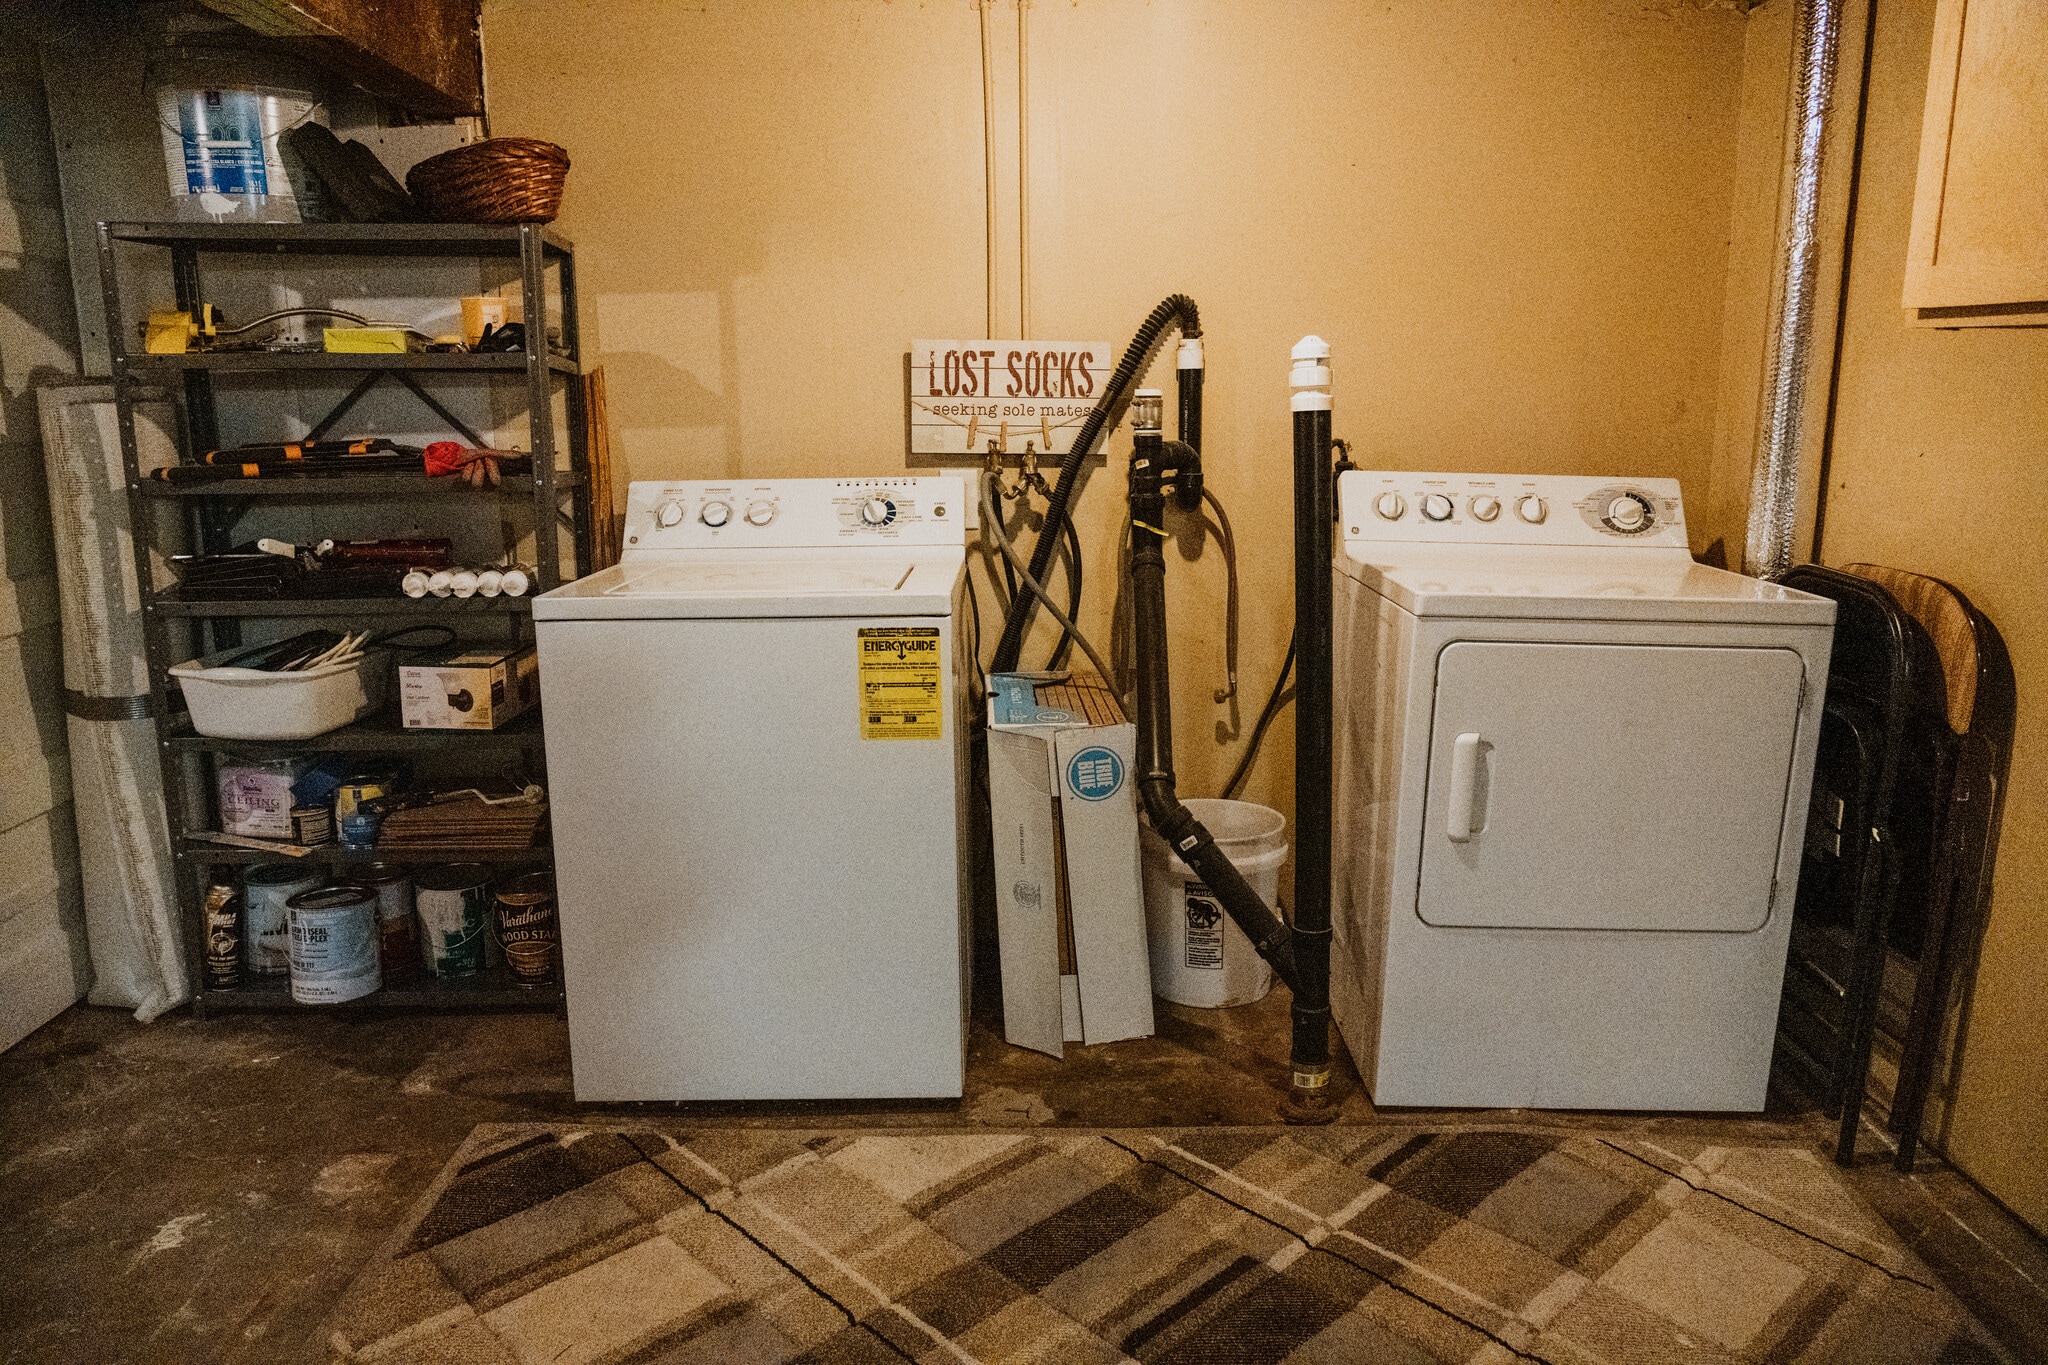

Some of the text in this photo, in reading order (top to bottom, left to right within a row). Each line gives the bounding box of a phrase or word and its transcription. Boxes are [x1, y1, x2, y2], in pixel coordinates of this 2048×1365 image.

[929, 350, 1094, 398] LOST SOCKS
[933, 403, 998, 418] seeking
[1003, 404, 1035, 417] sole
[1040, 405, 1092, 417] mates
[863, 640, 936, 653] ENERGYGUIDE
[1077, 760, 1097, 790] BLUE
[1095, 757, 1114, 787] TRUE
[227, 796, 280, 807] CEILING
